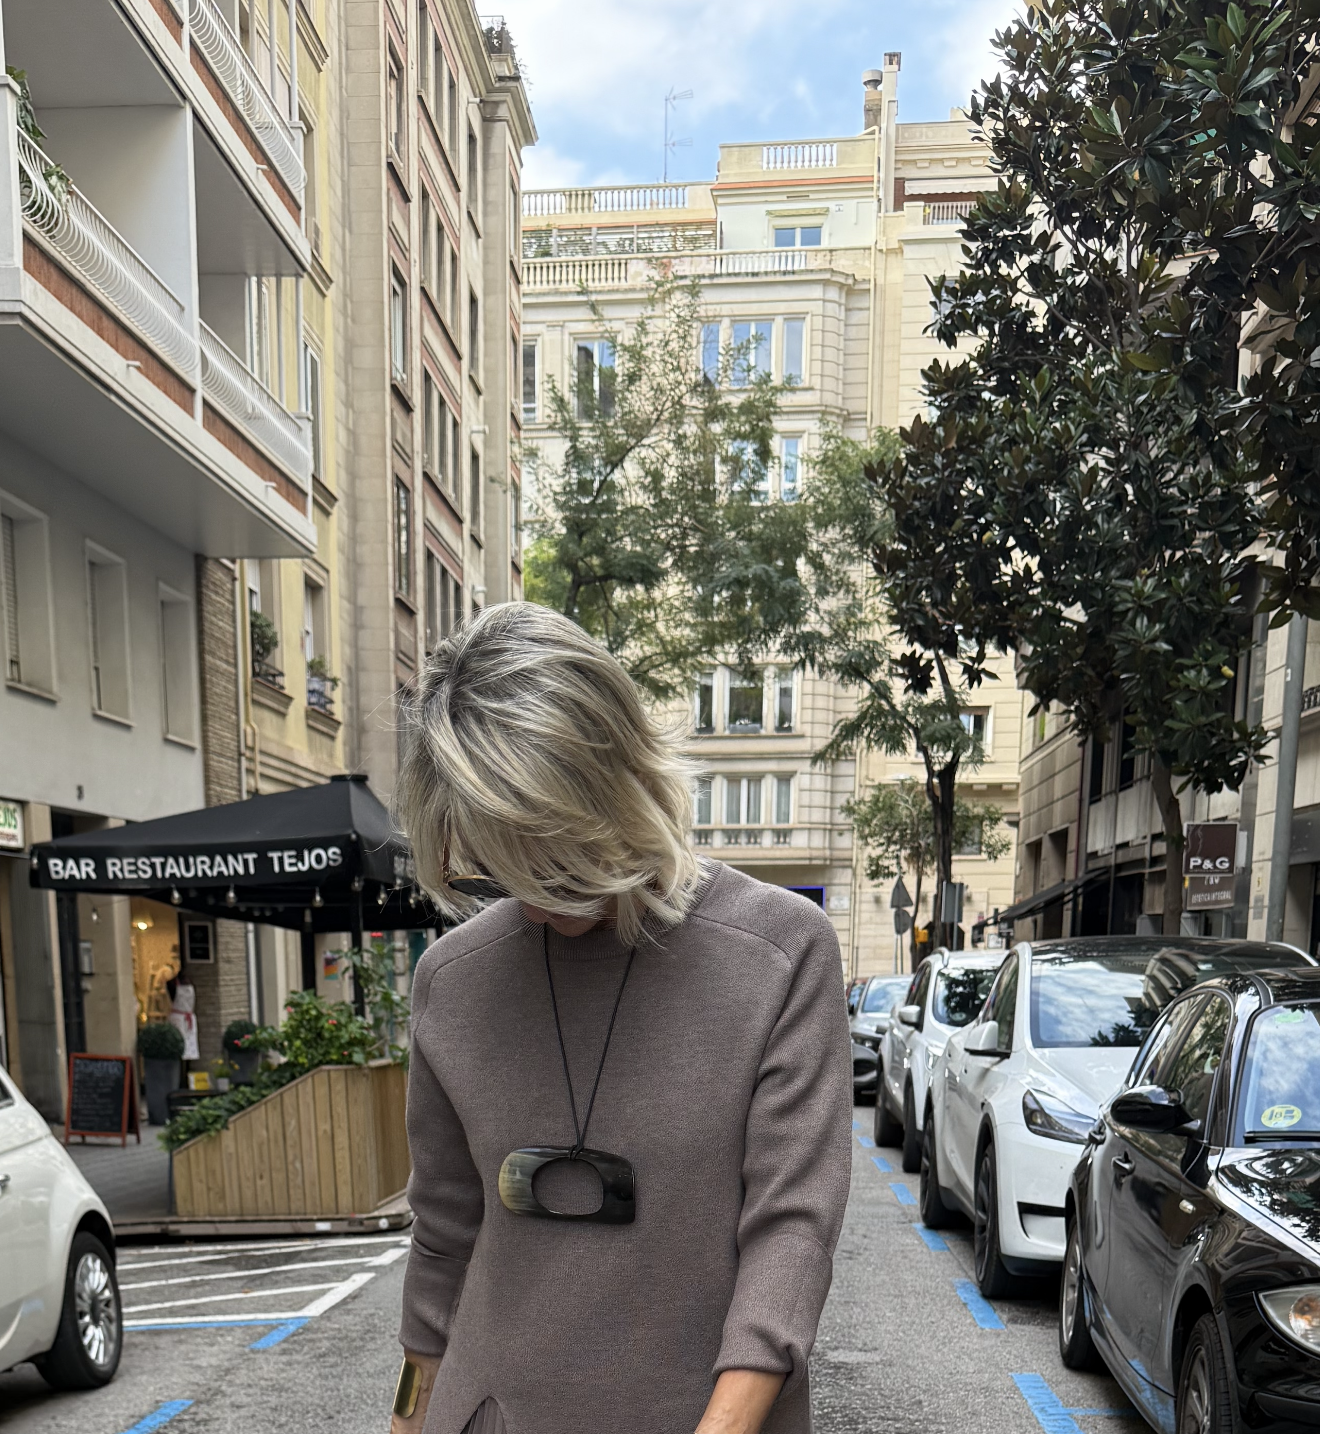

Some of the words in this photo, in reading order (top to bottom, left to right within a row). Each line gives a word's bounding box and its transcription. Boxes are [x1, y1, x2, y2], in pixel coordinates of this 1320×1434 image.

[47, 857, 97, 880] BAR
[106, 852, 258, 880] RESTAURANT
[267, 846, 343, 874] TEJOS
[1189, 857, 1230, 870] P&G
